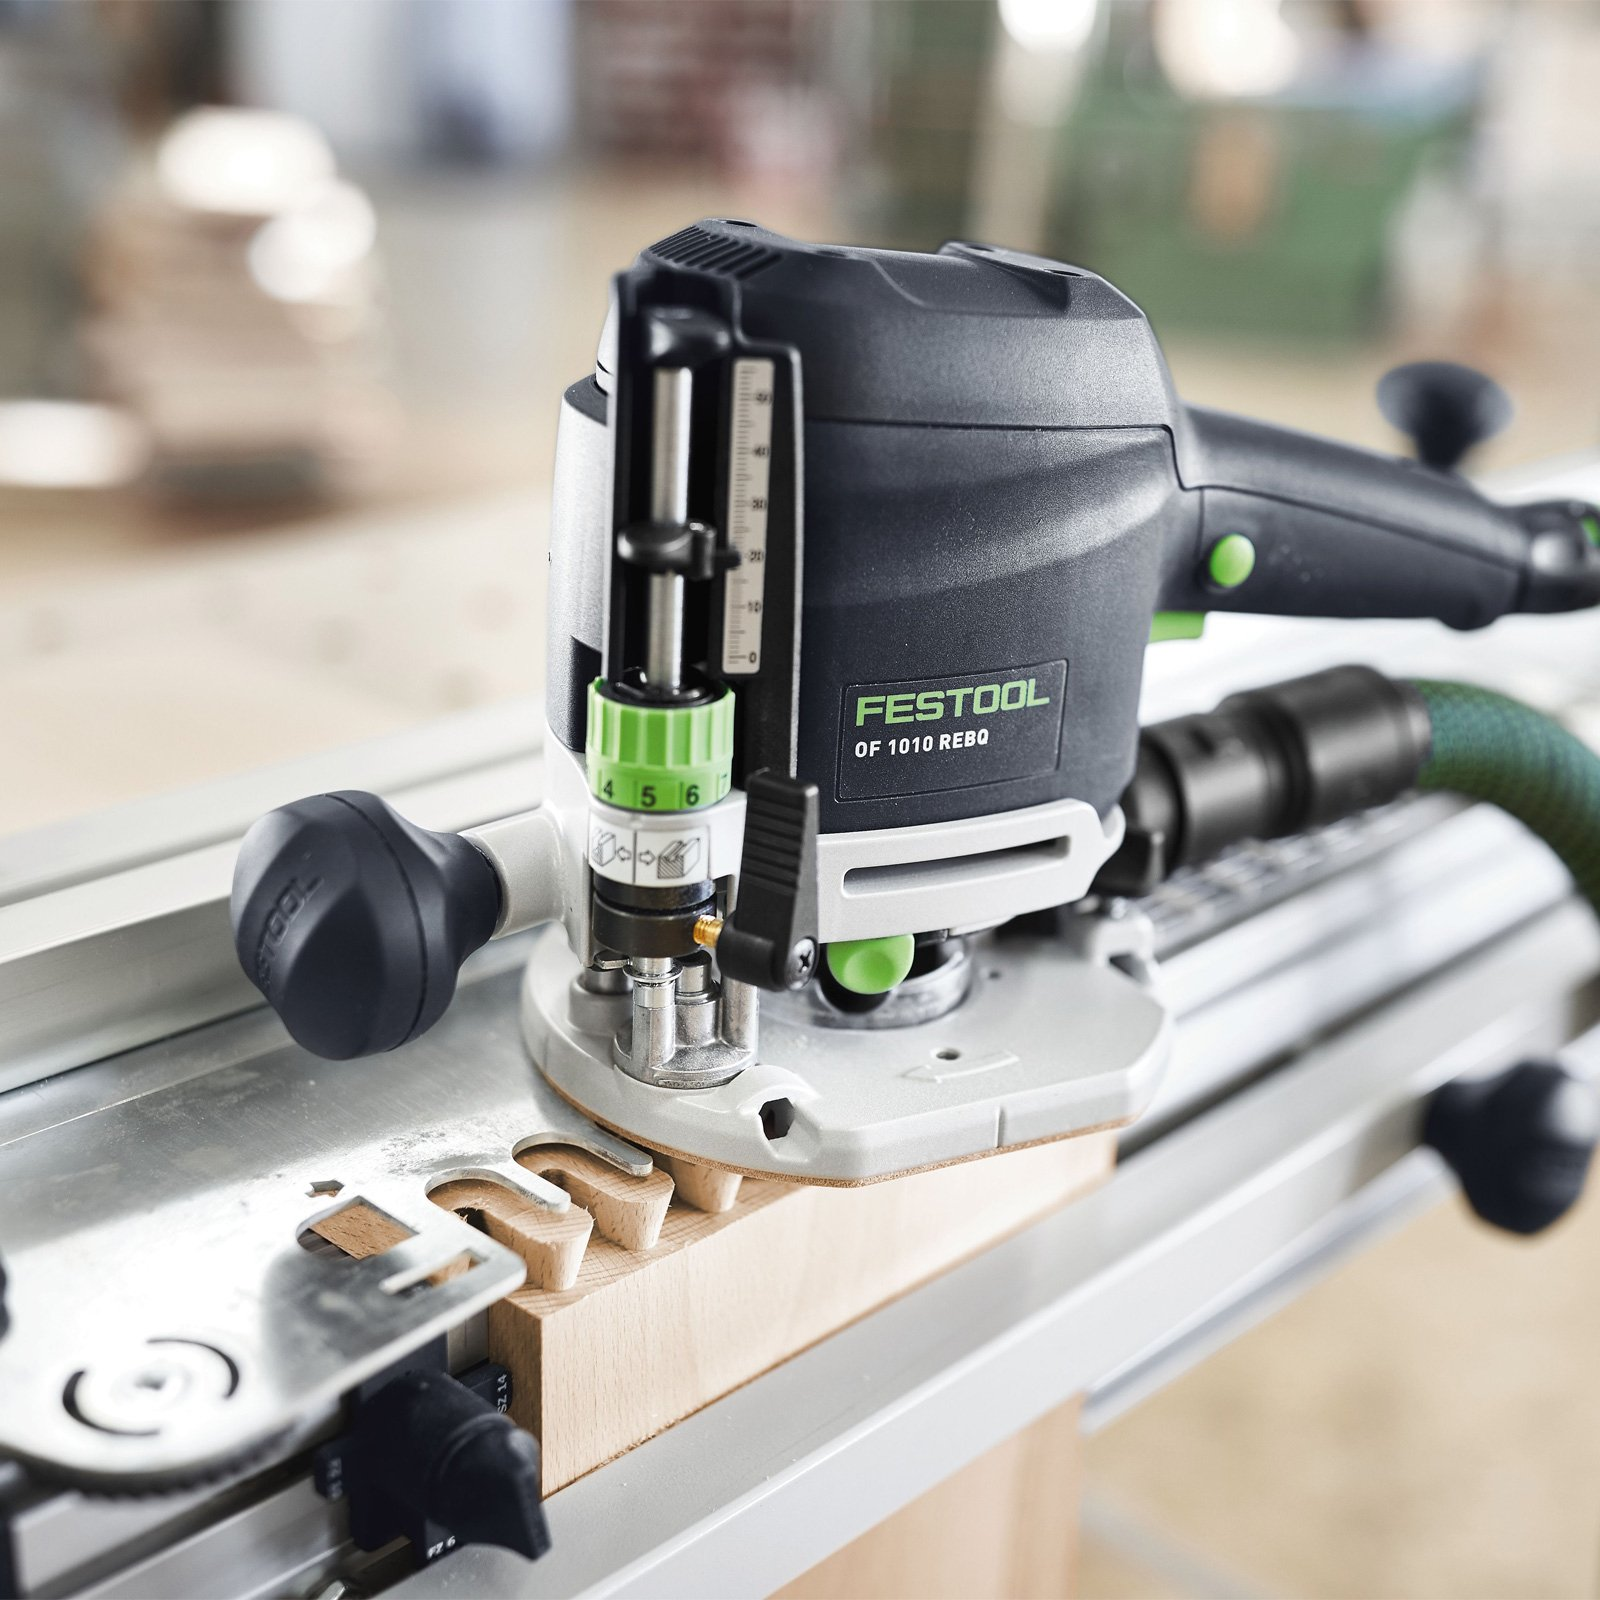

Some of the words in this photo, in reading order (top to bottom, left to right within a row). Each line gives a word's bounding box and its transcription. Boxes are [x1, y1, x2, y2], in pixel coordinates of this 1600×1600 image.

[749, 549, 764, 564] 20
[747, 600, 761, 613] 10
[748, 651, 757, 664] 0
[855, 678, 1050, 727] FESTOOL
[854, 740, 882, 758] OF
[888, 735, 934, 756] 1010
[939, 728, 989, 751] REBQ
[603, 779, 614, 799] 4
[641, 784, 656, 808] 5
[685, 784, 699, 806] 6
[446, 1535, 456, 1548] 6
